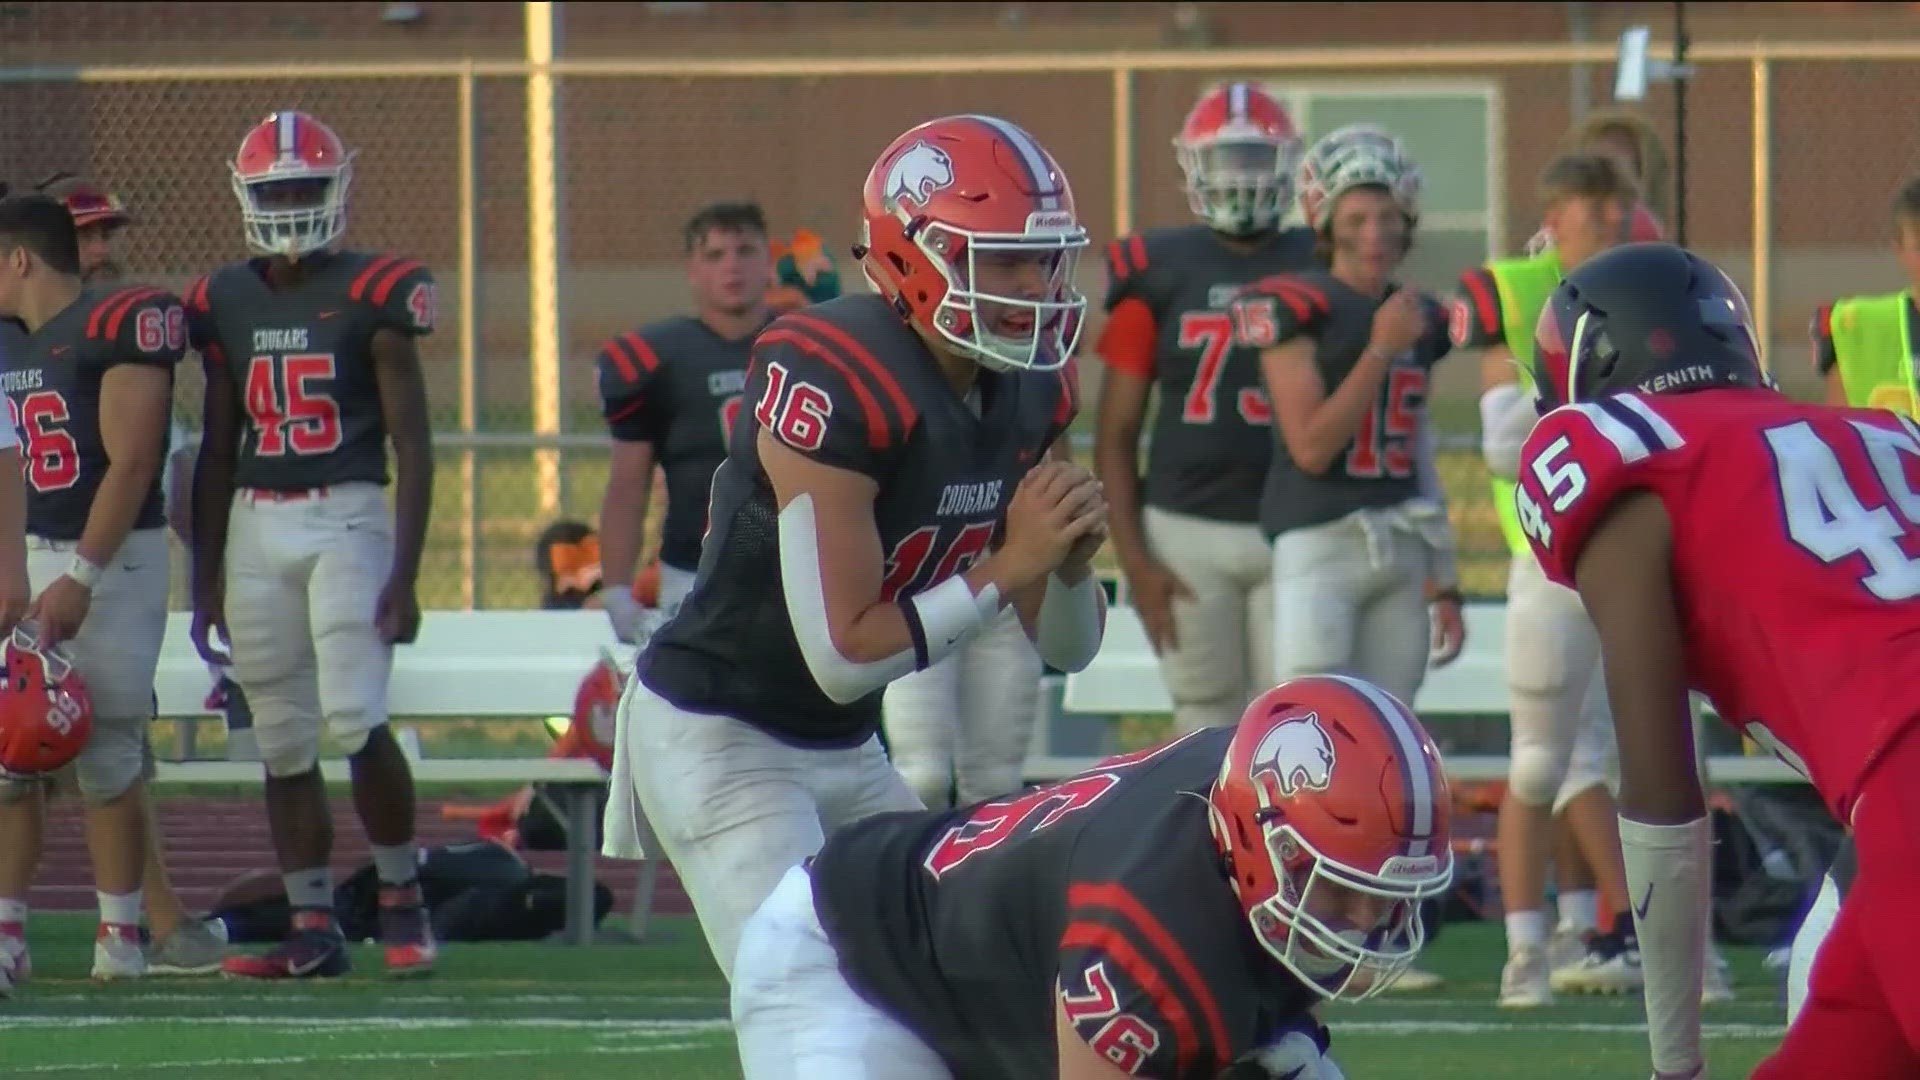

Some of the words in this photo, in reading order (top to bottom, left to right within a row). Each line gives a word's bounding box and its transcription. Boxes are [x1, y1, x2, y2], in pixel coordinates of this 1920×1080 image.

[253, 328, 308, 352] COUGARS
[1231, 299, 1279, 347] 15
[245, 353, 343, 456] 45
[755, 361, 833, 451] 16
[1637, 364, 1714, 395] XENITH
[7, 391, 81, 492] 6
[936, 479, 1003, 516] COUGARS
[1515, 434, 1588, 551] 45
[1060, 961, 1160, 1076] 76
